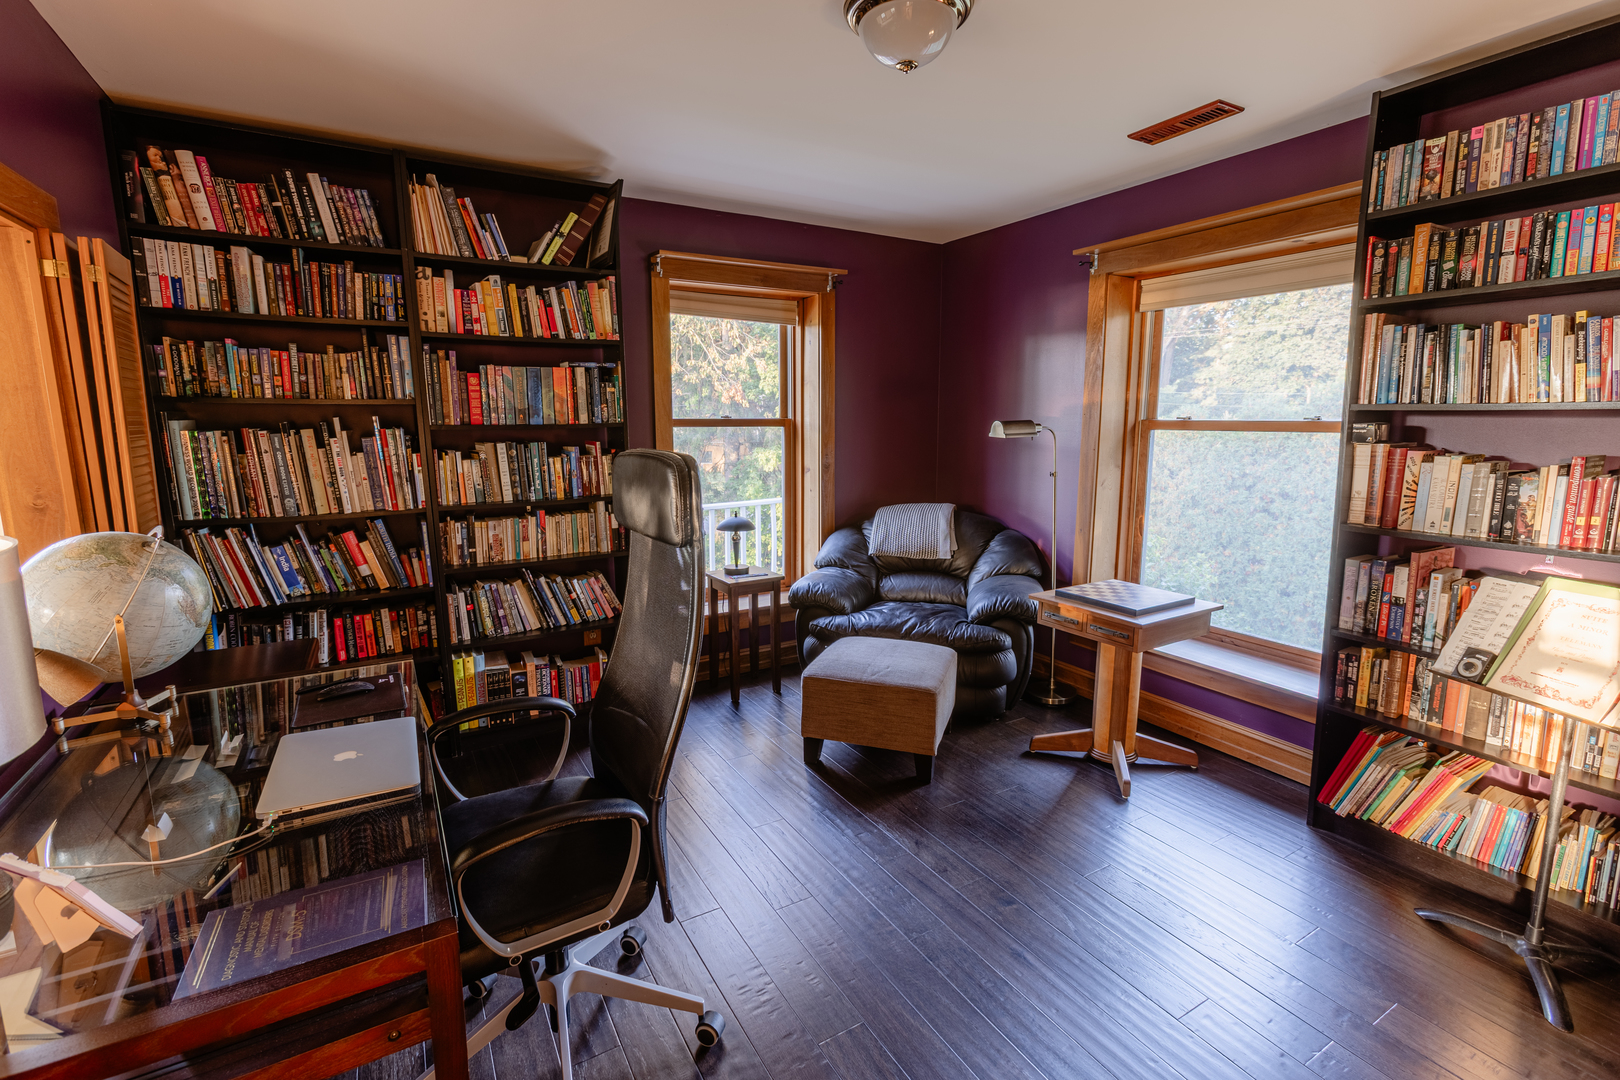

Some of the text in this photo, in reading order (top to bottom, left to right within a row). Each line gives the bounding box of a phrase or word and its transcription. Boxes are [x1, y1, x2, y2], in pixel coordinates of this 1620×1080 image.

[201, 162, 209, 176] ANNE
[204, 176, 212, 186] RICE
[214, 213, 223, 227] EDEN
[1504, 230, 1516, 251] ANN RULE
[183, 258, 191, 276] FRENCH
[435, 281, 444, 306] SHANTARAM
[1577, 331, 1585, 360] Beekeeping
[185, 458, 193, 476] WORLD
[246, 450, 257, 481] ELEPHANT
[326, 446, 335, 472] HUNDRED
[332, 474, 340, 498] FLOWERS
[1410, 457, 1418, 467] GODS
[1429, 477, 1439, 509] KAMA SUTRA
[1447, 480, 1456, 500] INDIA
[1566, 466, 1582, 524] companion guide
[376, 523, 389, 543] SOUTH
[385, 543, 397, 559] INDIA
[279, 556, 290, 572] India
[1368, 580, 1379, 612] BROKEN
[1389, 607, 1397, 629] DOBRYNIN
[1577, 624, 1609, 636] MINOR
[456, 679, 465, 703] PEANUTS
[467, 677, 475, 702] PEANUTS
[478, 683, 486, 704] PEANUT
[286, 910, 306, 941] DSM-5
